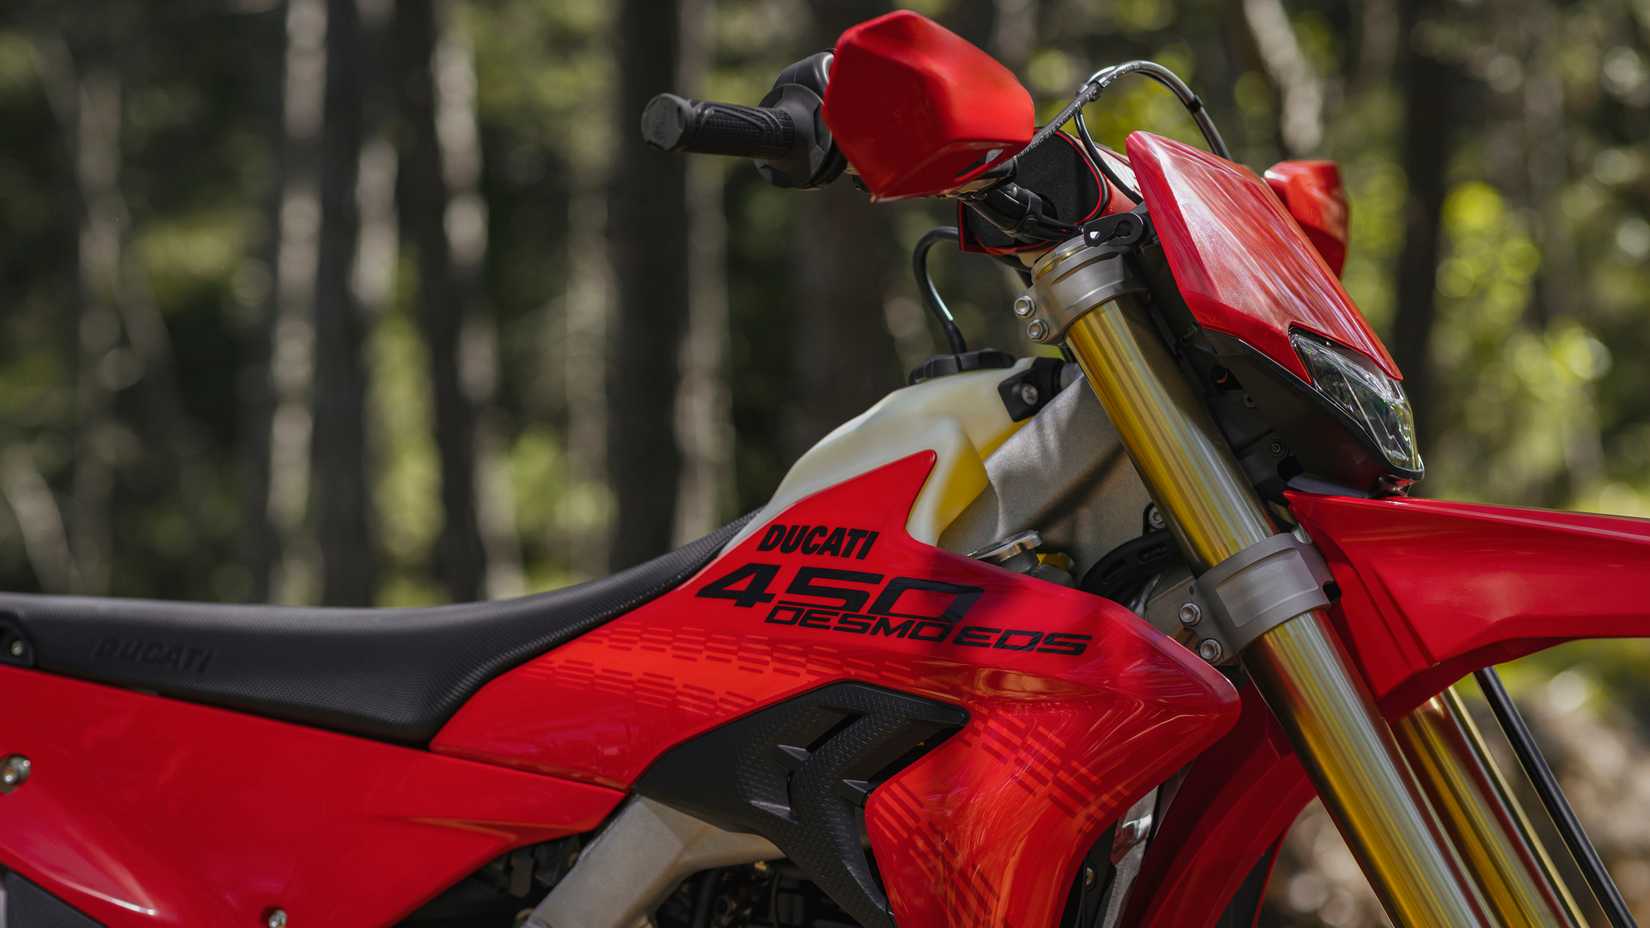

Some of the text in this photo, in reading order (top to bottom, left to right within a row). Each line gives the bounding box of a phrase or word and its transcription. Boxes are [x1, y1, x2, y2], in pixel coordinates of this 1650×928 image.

[756, 524, 879, 560] DUCATI
[695, 563, 984, 624] 450
[764, 605, 1093, 656] DESMO EDS
[92, 638, 213, 673] DUCATI
